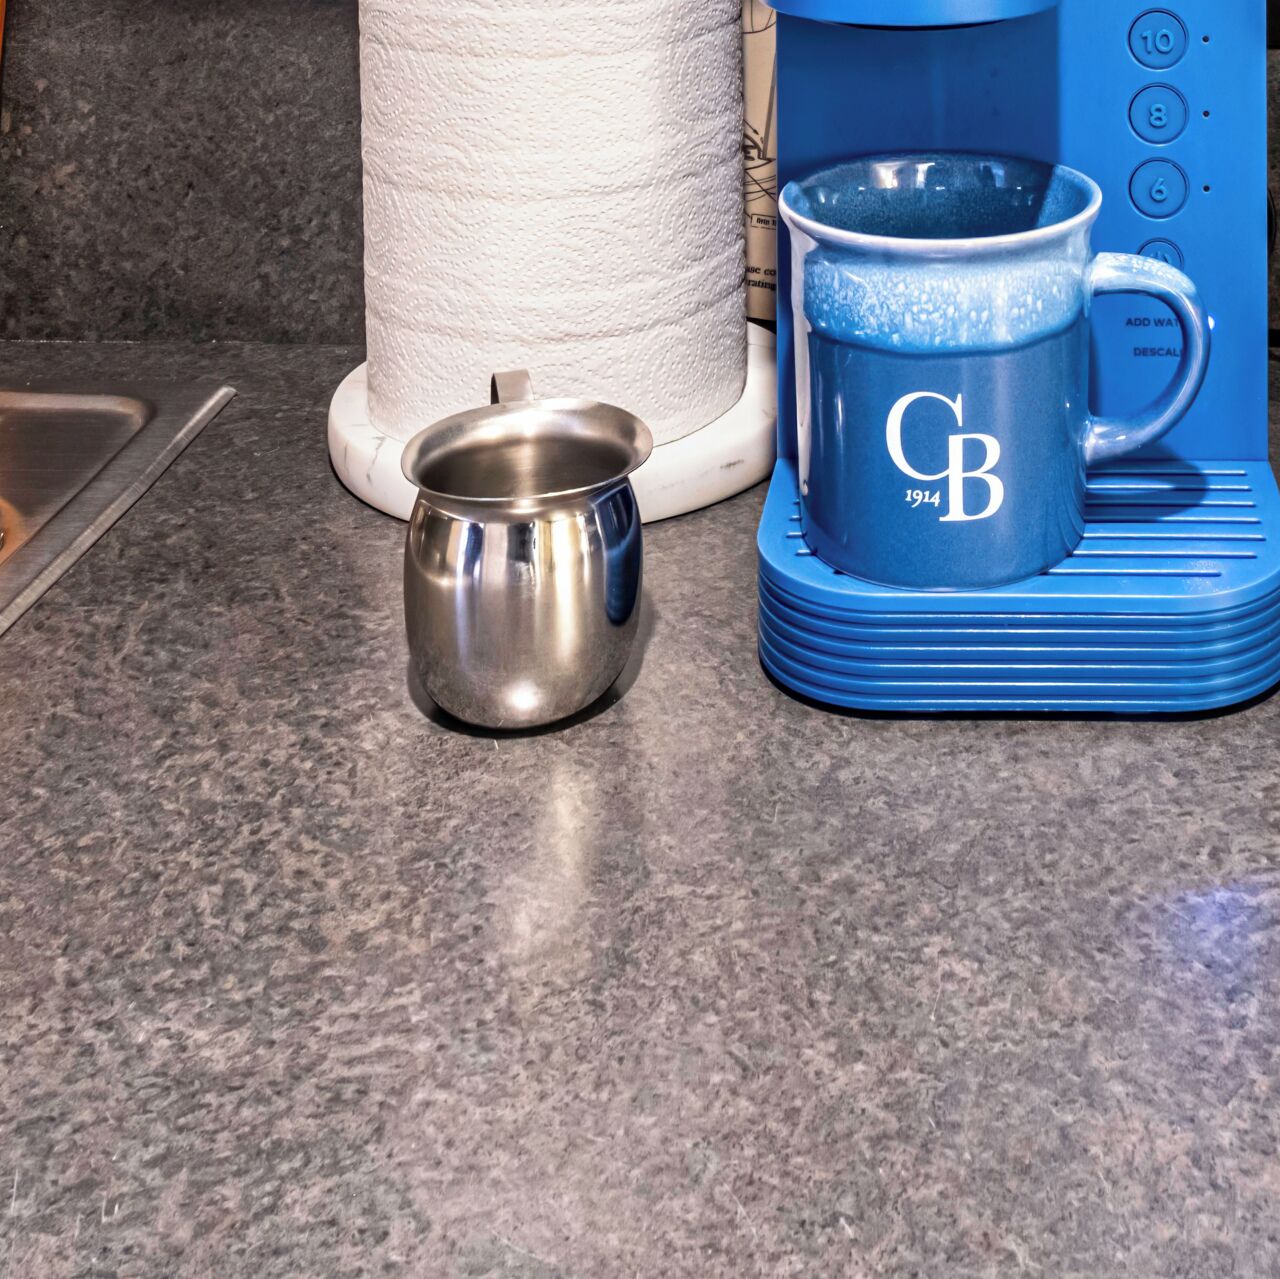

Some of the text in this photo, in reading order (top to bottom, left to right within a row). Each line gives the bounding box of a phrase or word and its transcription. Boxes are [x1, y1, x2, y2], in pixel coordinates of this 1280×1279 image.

[1140, 28, 1175, 54] 10
[1149, 103, 1167, 129] 8
[1149, 177, 1168, 203] 6
[1125, 317, 1181, 328] ADD WAT
[1133, 346, 1181, 357] DESCAL
[904, 489, 941, 508] 1914
